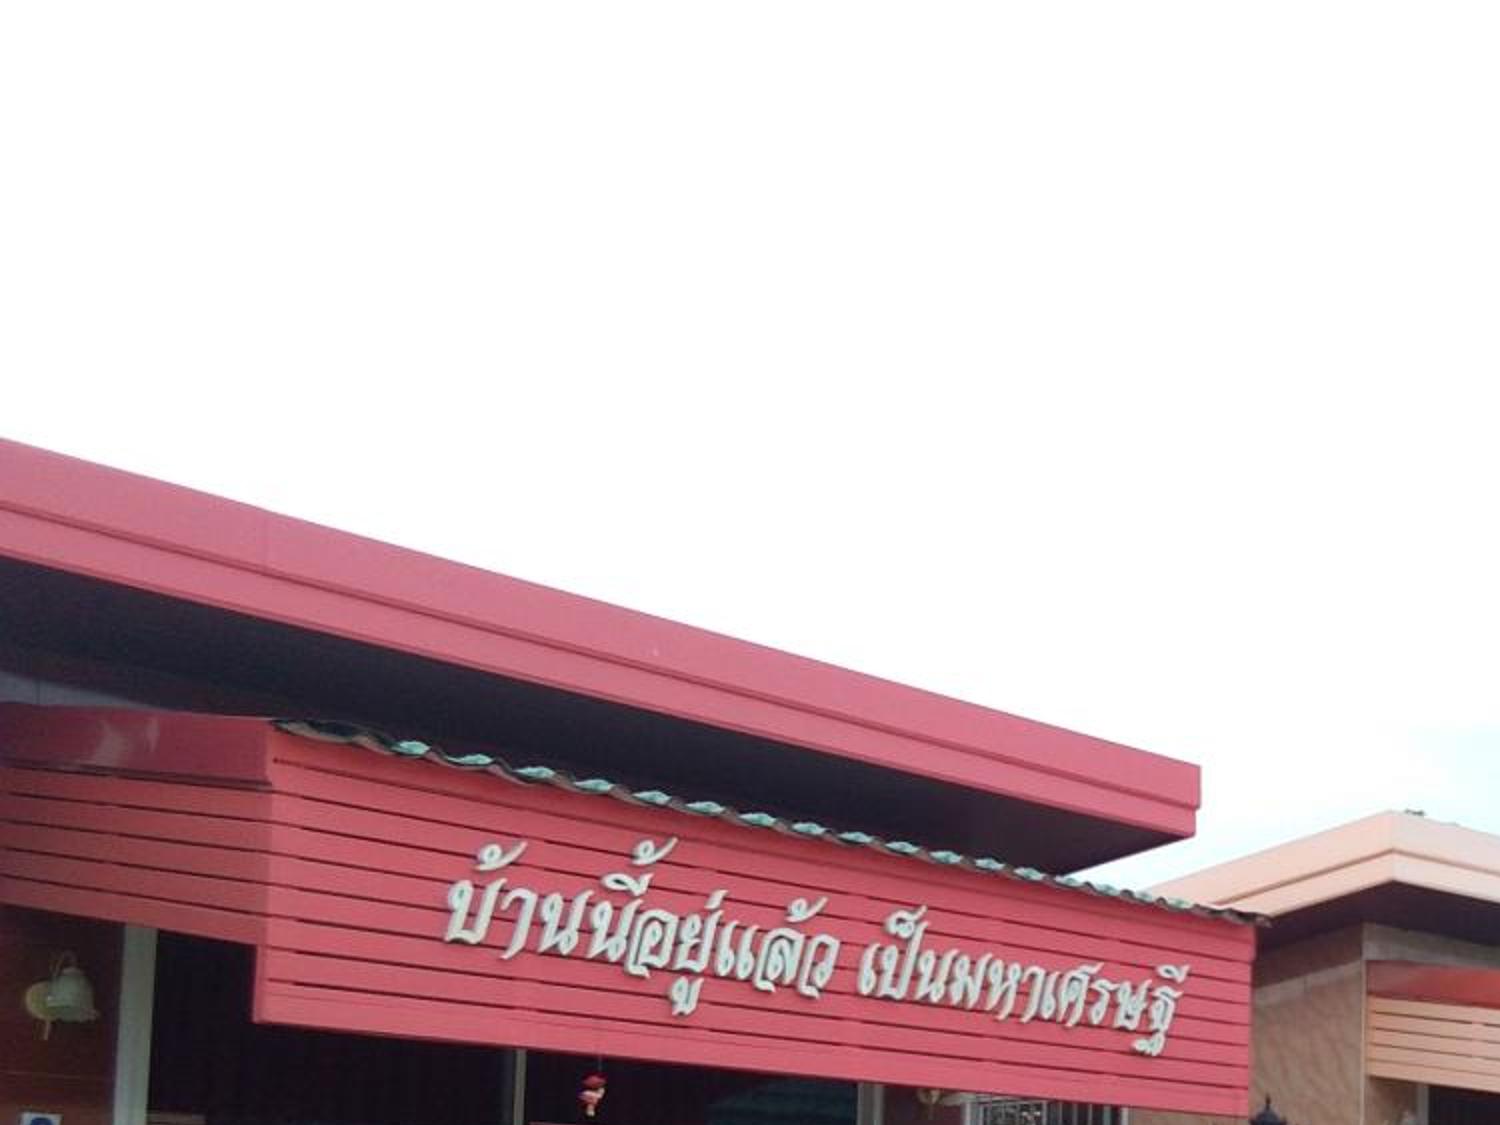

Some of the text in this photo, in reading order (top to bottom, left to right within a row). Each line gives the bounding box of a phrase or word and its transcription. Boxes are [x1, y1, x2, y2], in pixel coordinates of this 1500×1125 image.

[443, 837, 1189, 1057] บ้านนี้อยู่แล้ว เป็นมหาเศรษฐี
